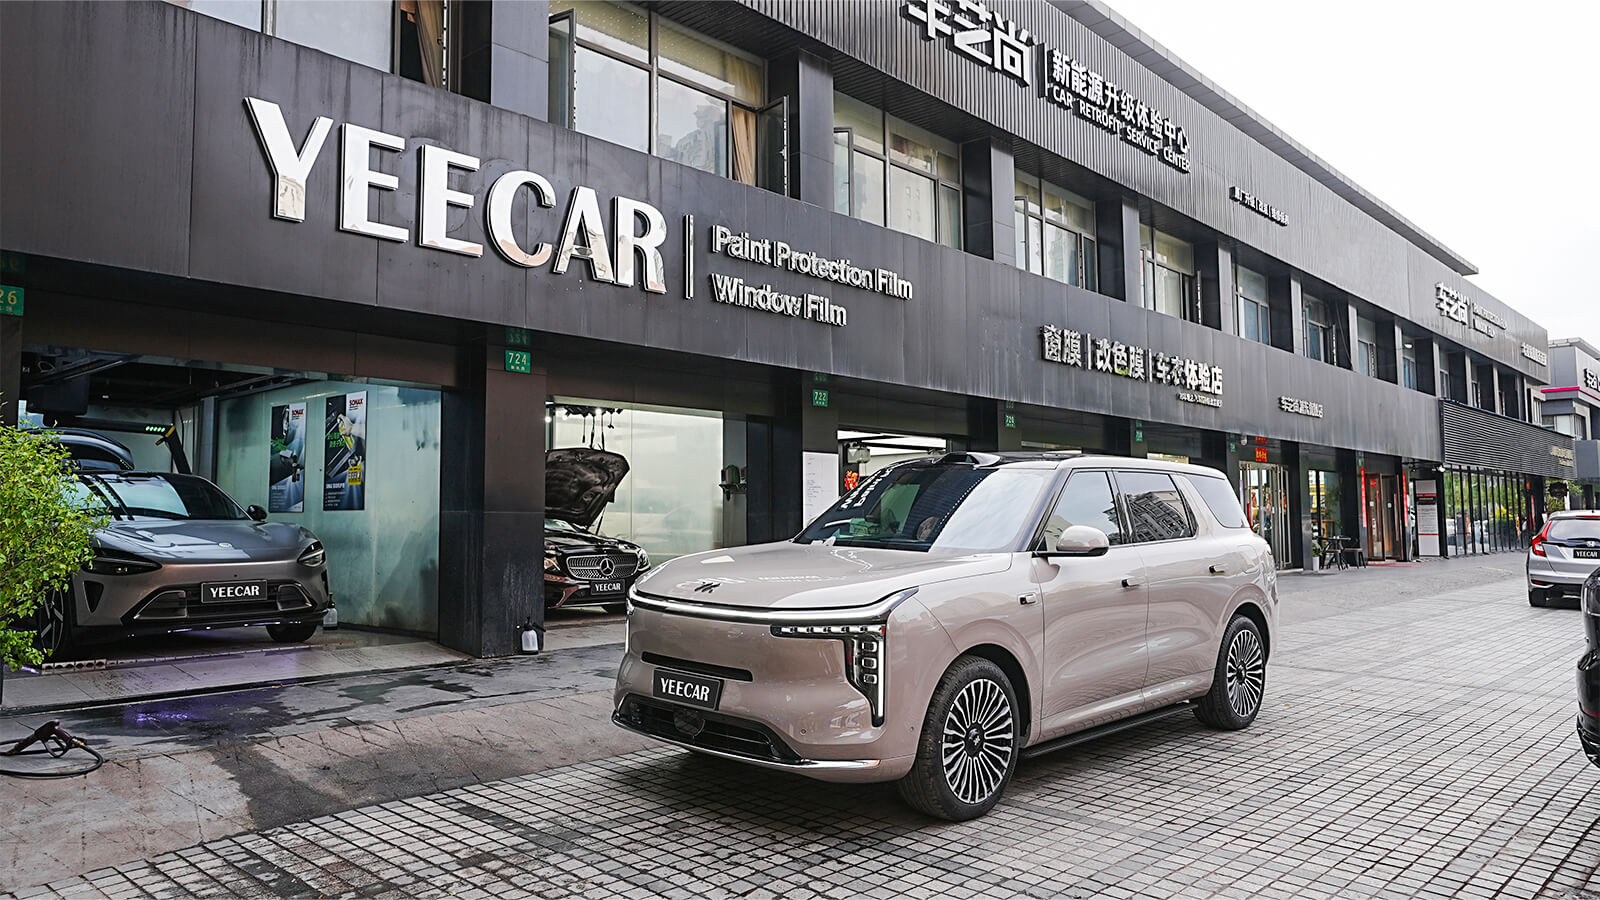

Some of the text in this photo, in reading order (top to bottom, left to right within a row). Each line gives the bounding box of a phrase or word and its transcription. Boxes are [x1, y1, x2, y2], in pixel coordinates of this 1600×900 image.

[1053, 49, 1190, 154] 新能源升级体验中心
[1053, 85, 1190, 173] CAR RETROFIT SERVICE CENTER
[244, 97, 667, 294] YEECAR
[712, 224, 913, 300] Paint Protection Film
[712, 273, 848, 327] Window Film
[508, 353, 527, 365] 724
[1042, 324, 1223, 395] 窗膜 改色膜 车衣体验店
[814, 391, 826, 402] 722
[210, 585, 260, 598] YEECAR
[595, 583, 621, 592] YEECAR
[660, 677, 710, 702] YEECAR
